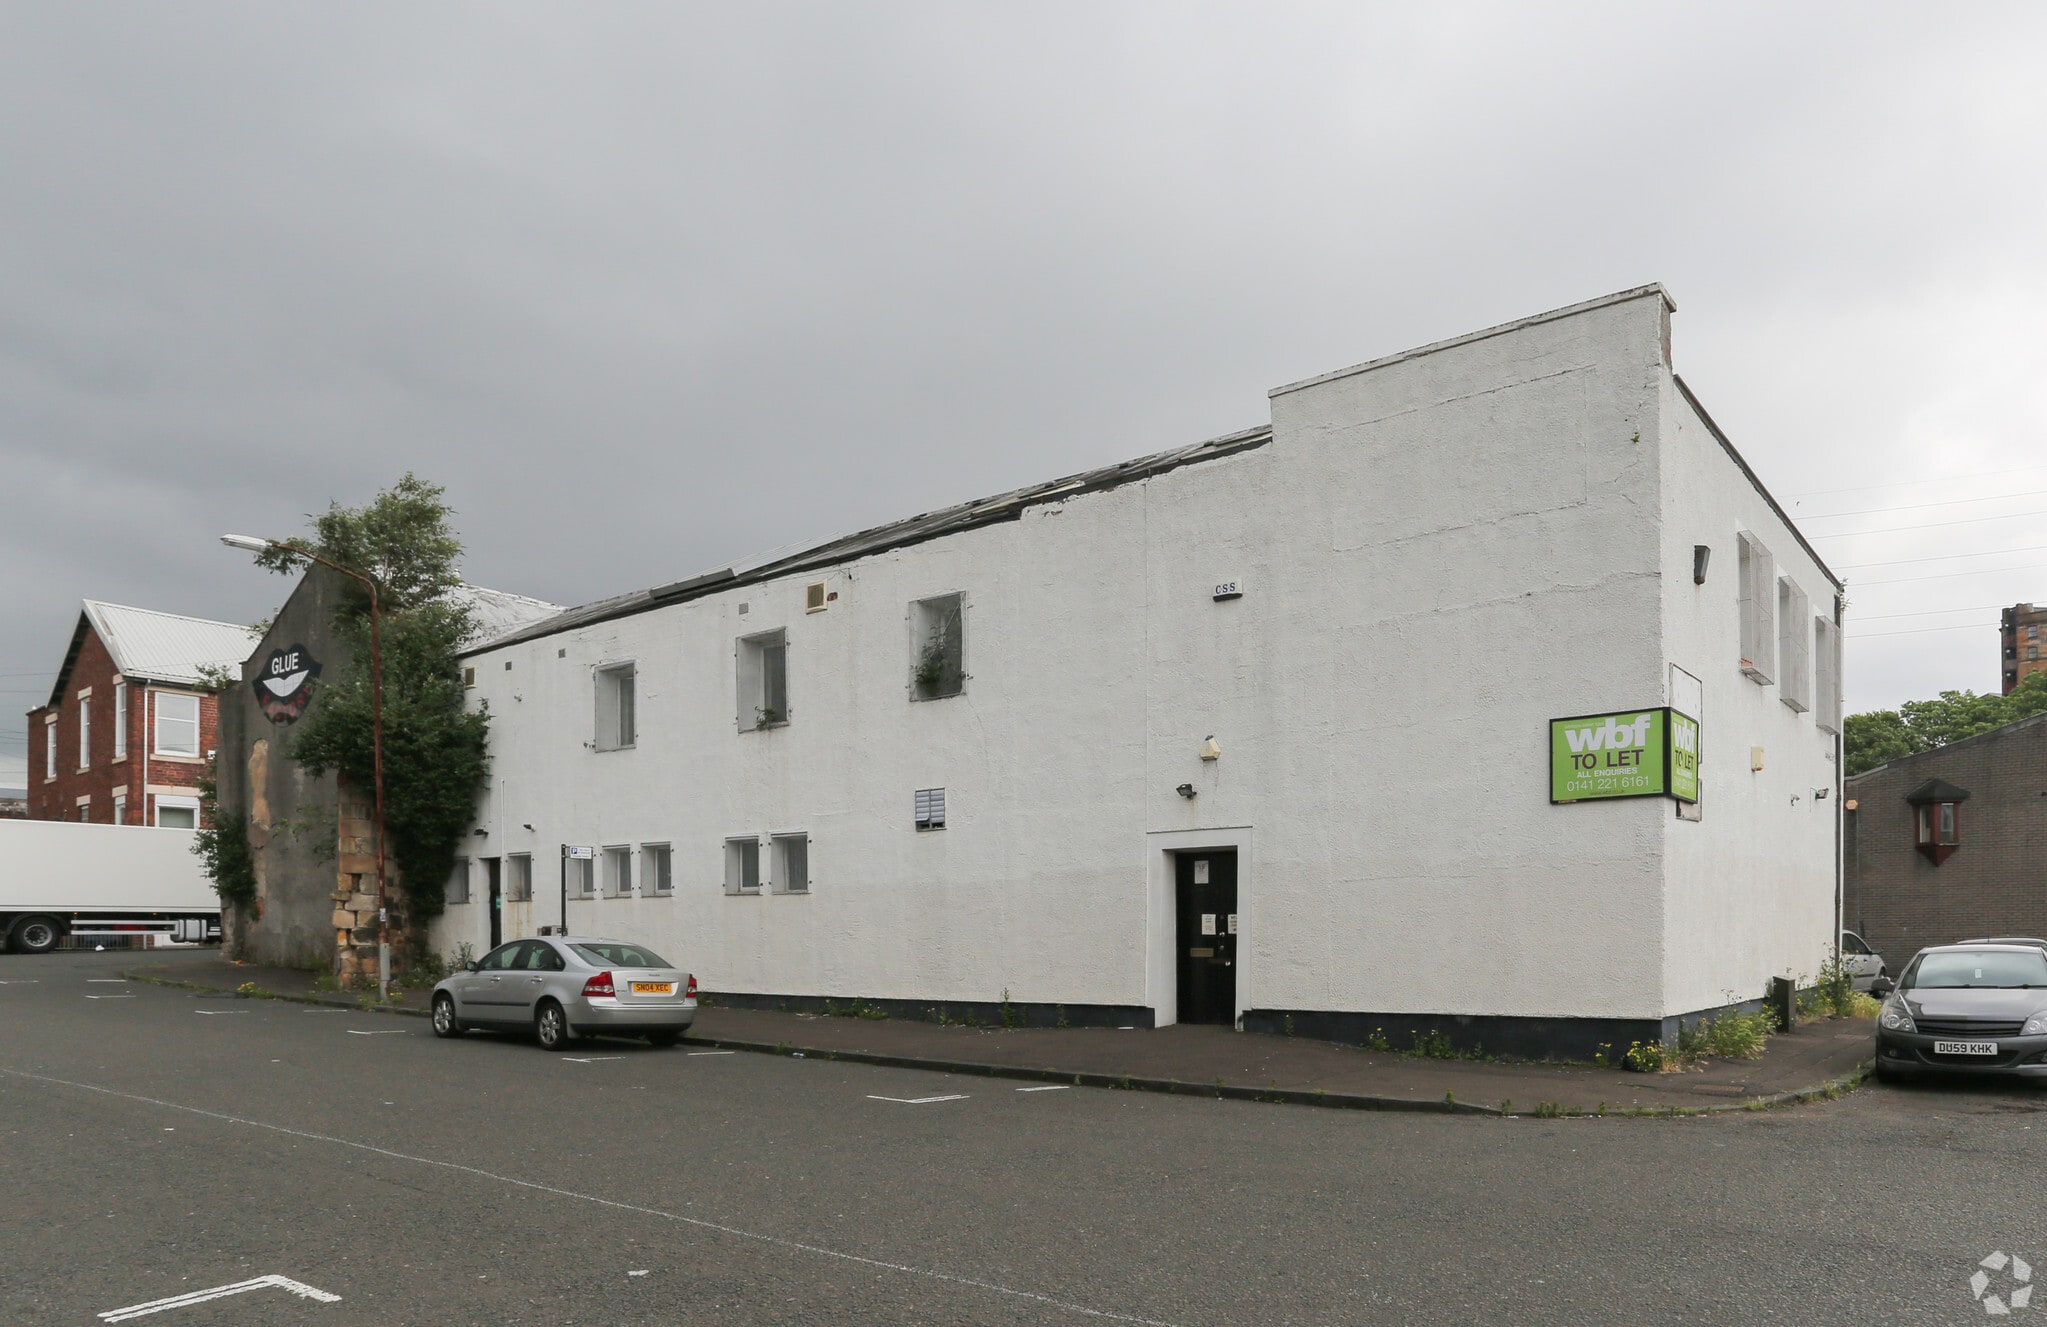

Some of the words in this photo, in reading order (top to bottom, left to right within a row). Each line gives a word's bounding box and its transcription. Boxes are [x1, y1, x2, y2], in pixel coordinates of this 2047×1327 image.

[271, 652, 299, 675] GLUE
[1565, 714, 1651, 752] wbf
[1571, 753, 1597, 770] TO
[1607, 749, 1644, 768] LET
[1577, 771, 1591, 779] ALL
[1594, 767, 1638, 777] ENQUIRIES
[1567, 780, 1593, 792] 0141
[1598, 778, 1617, 790] 221
[1621, 776, 1649, 788] 6161
[636, 983, 654, 992] SN04
[656, 983, 669, 992] XEC
[1939, 1043, 1967, 1053] DU59
[1970, 1044, 1993, 1054] KHK
